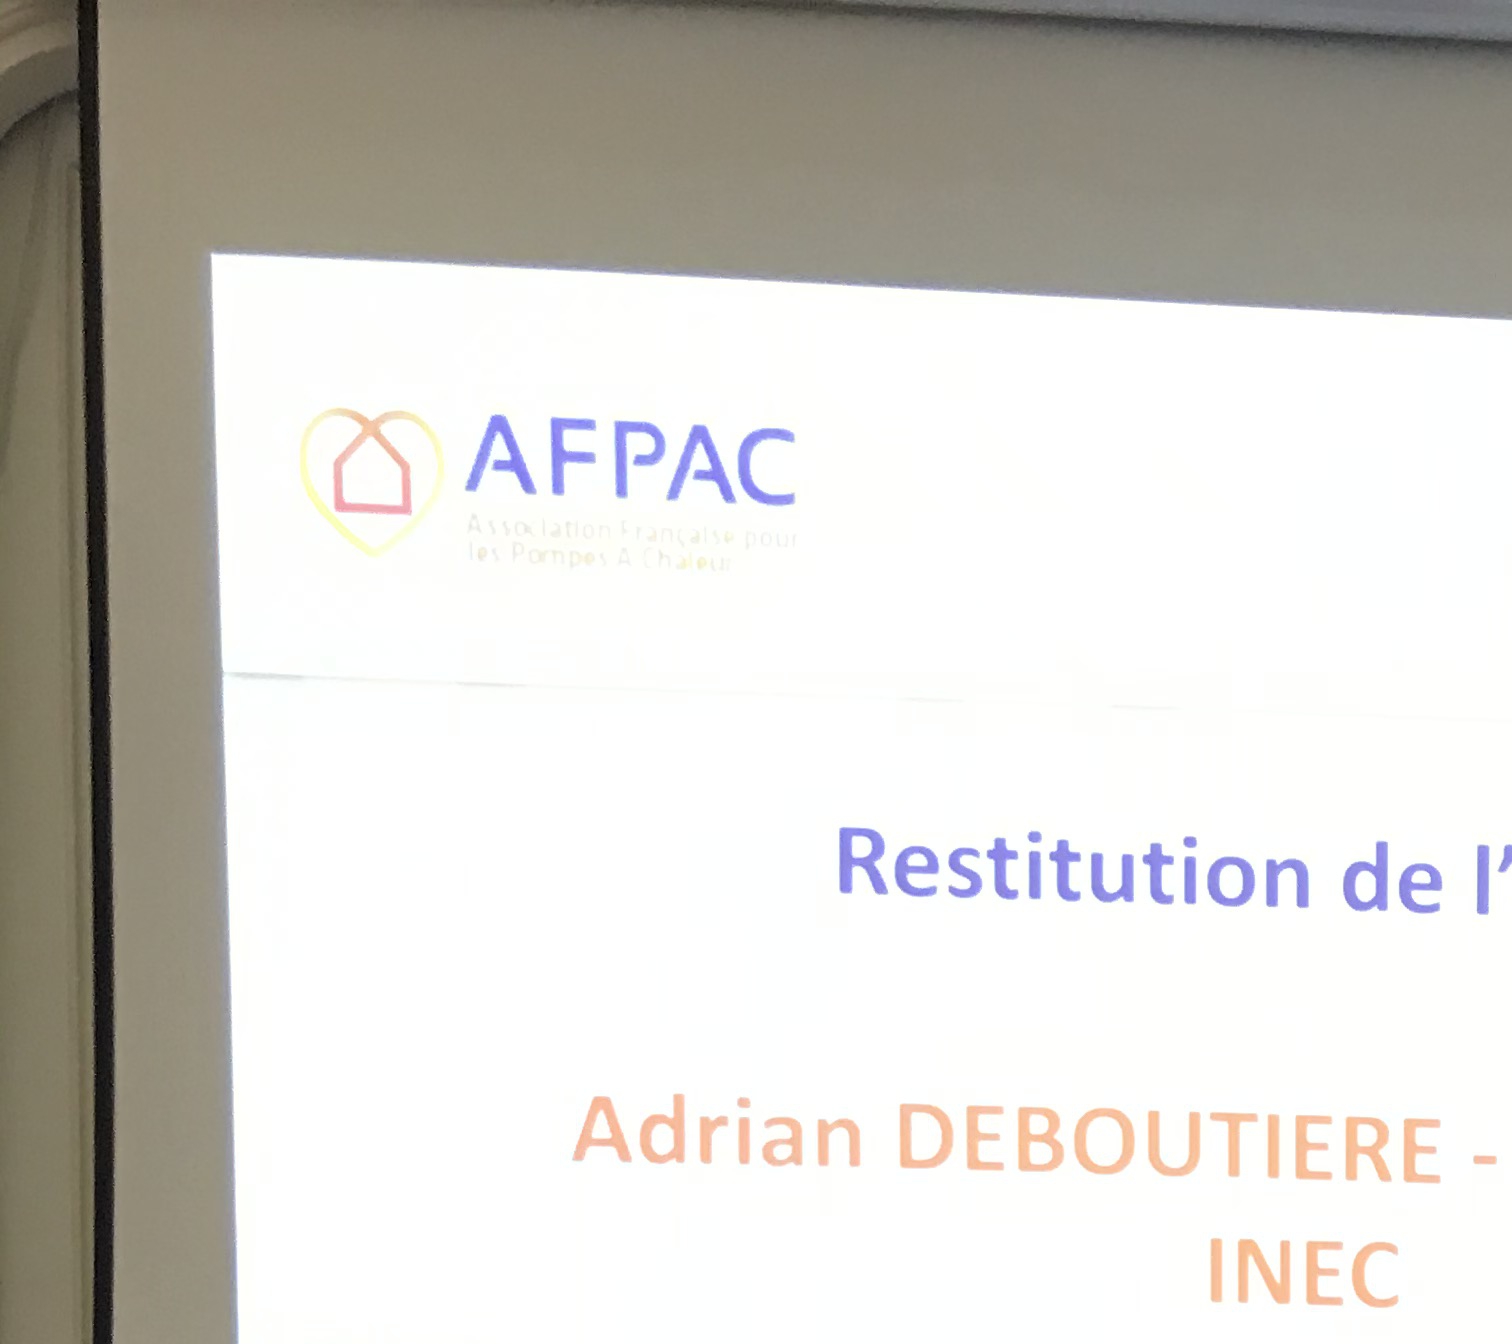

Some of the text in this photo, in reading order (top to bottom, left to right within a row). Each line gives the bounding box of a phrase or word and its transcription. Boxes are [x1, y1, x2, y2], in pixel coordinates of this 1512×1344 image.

[464, 413, 797, 507] AFPAC
[838, 826, 1310, 909] Restitution
[1342, 840, 1443, 915] de
[572, 1093, 862, 1168] Adrian
[899, 1103, 1442, 1184] DEBOUTIERE
[1472, 1153, 1498, 1166] -
[1209, 1237, 1400, 1309] INEC
